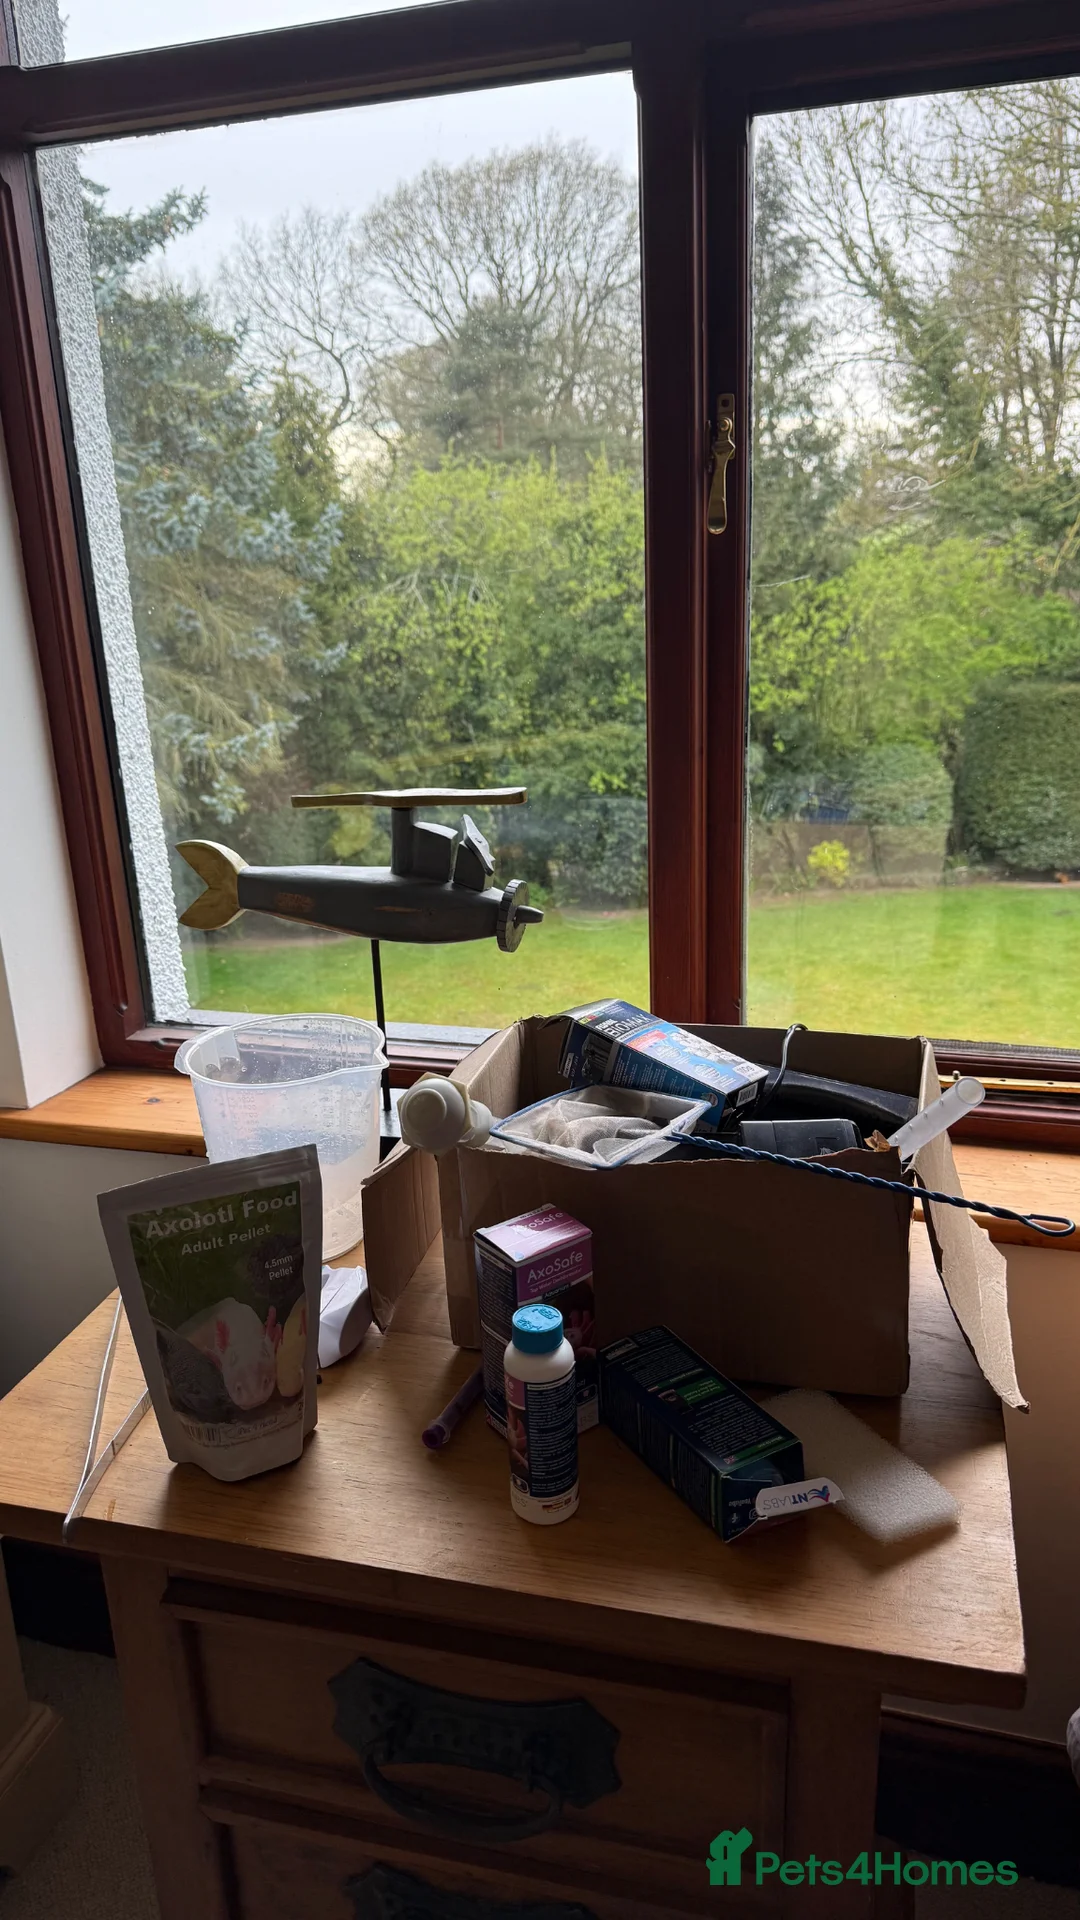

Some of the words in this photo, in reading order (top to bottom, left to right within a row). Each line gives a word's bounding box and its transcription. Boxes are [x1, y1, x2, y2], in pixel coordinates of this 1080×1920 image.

[603, 1013, 653, 1038] BIOMAX
[146, 1205, 234, 1239] Axolotl
[241, 1190, 298, 1220] Food
[181, 1236, 225, 1256] Adult
[228, 1223, 272, 1246] Pellet
[263, 1254, 294, 1270] 4.5mm
[268, 1265, 294, 1281] Pellet
[527, 1251, 583, 1284] AxoSafe
